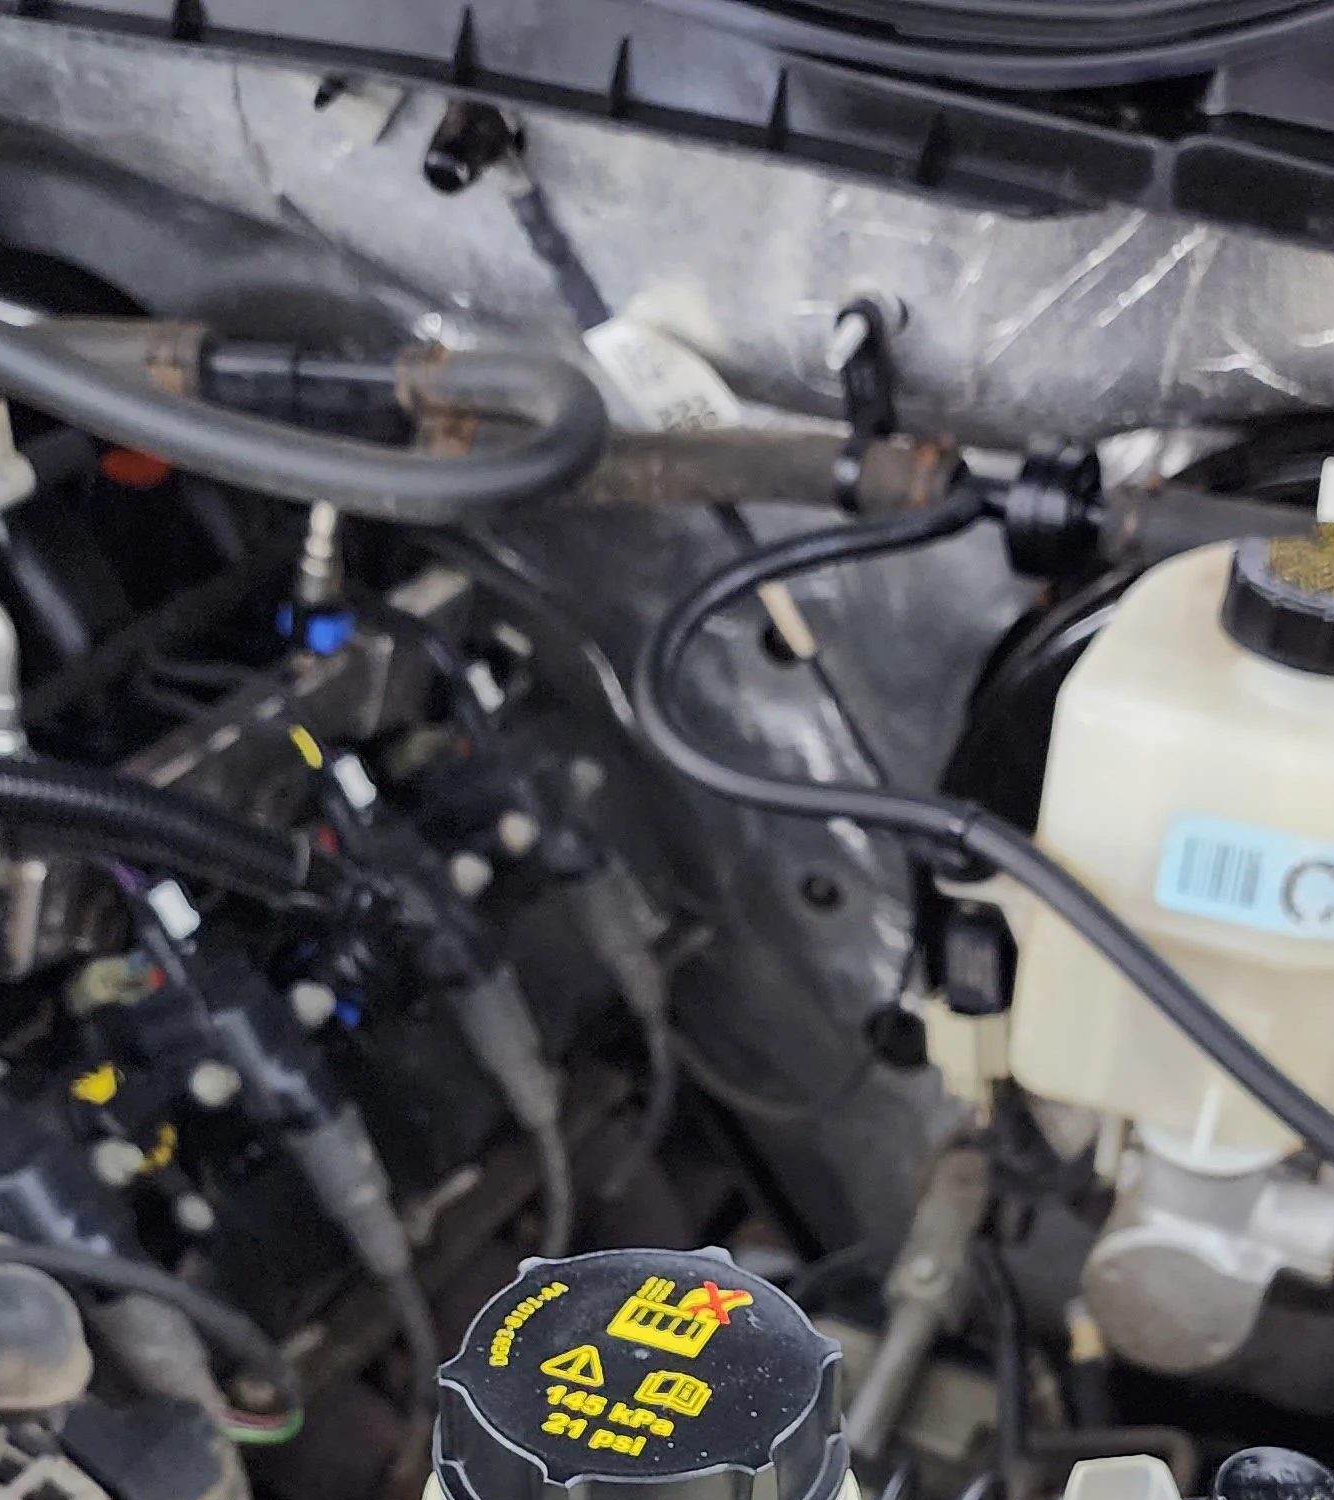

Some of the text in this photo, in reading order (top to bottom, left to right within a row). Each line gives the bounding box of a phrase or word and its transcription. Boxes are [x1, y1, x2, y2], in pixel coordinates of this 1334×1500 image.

[540, 1411, 647, 1457] 21 psi
[546, 1384, 675, 1437] 145 kPa
